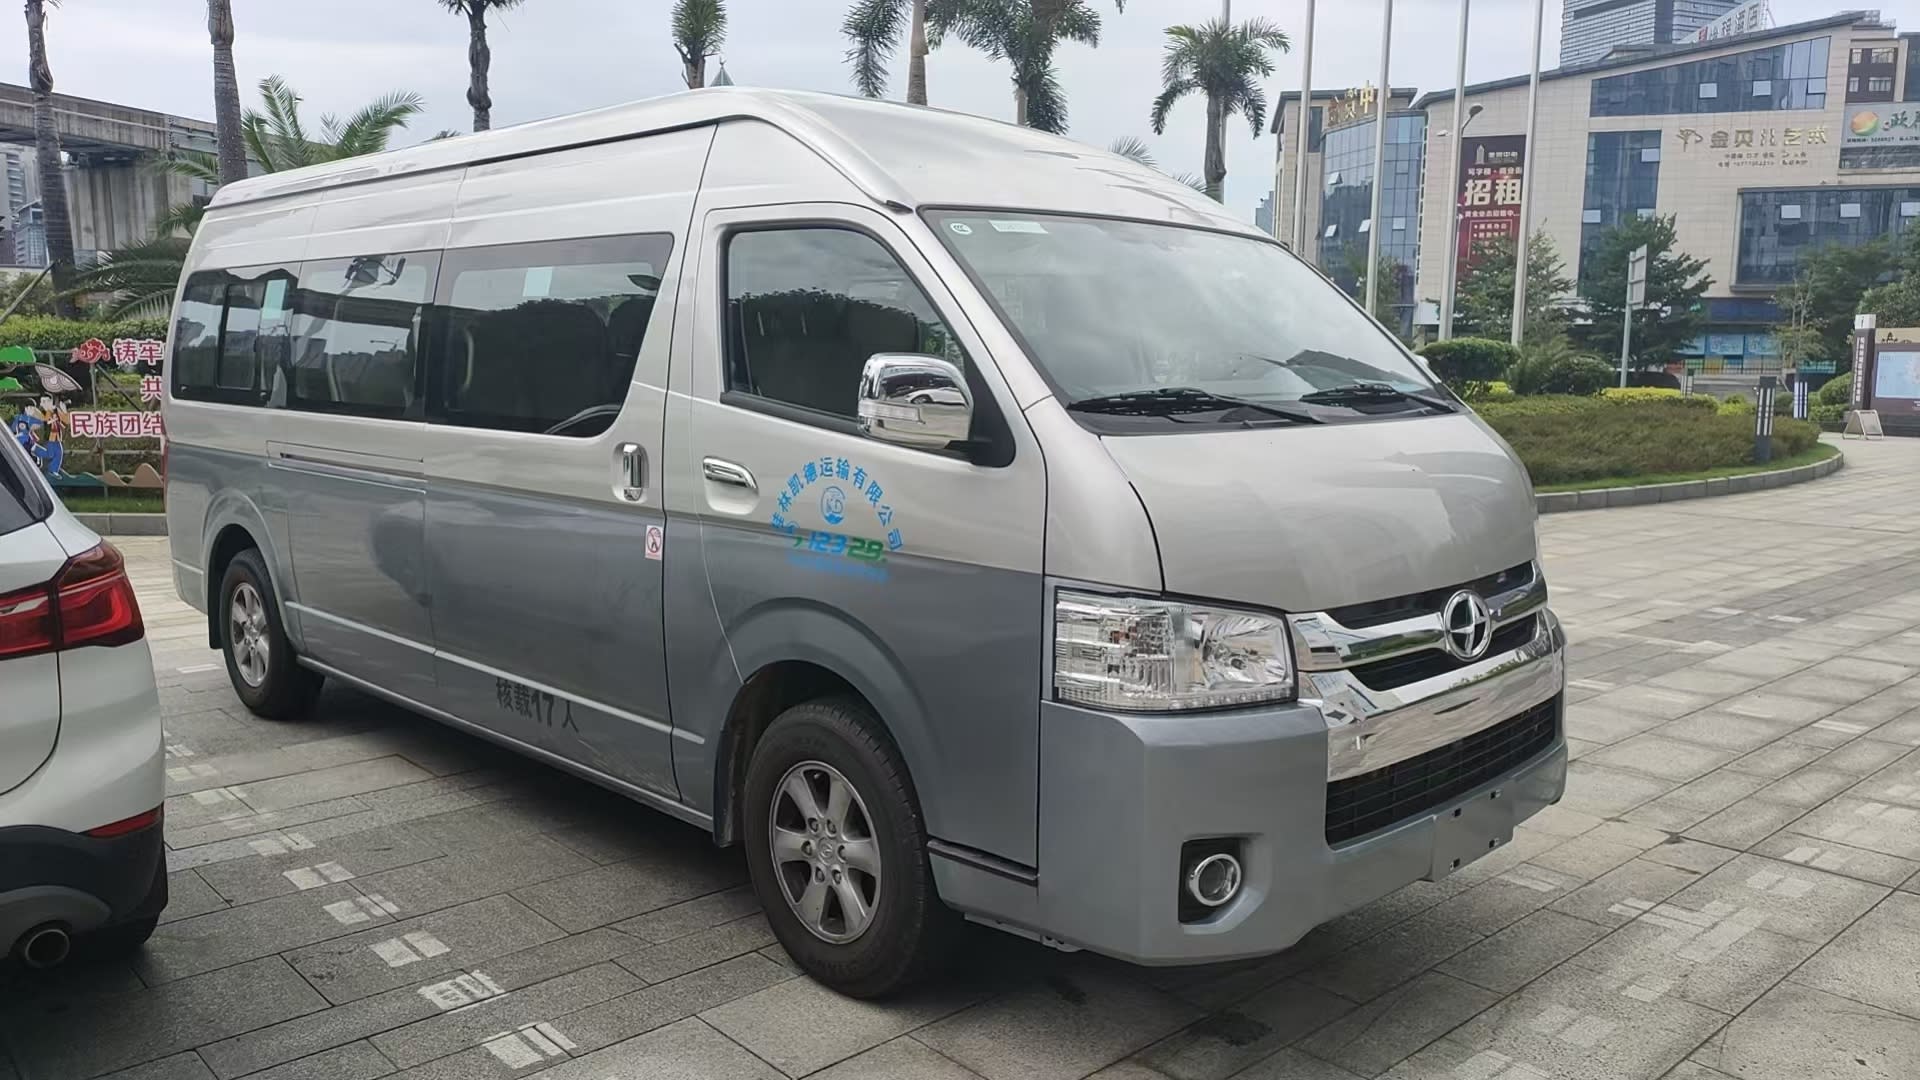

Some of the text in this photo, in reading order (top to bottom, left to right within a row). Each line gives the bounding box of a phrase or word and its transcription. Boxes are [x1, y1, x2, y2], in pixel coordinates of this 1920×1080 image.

[1464, 179, 1521, 207] 招租
[142, 376, 162, 401] 共
[71, 412, 162, 437] 民族团结
[496, 677, 579, 733] 核载17人
